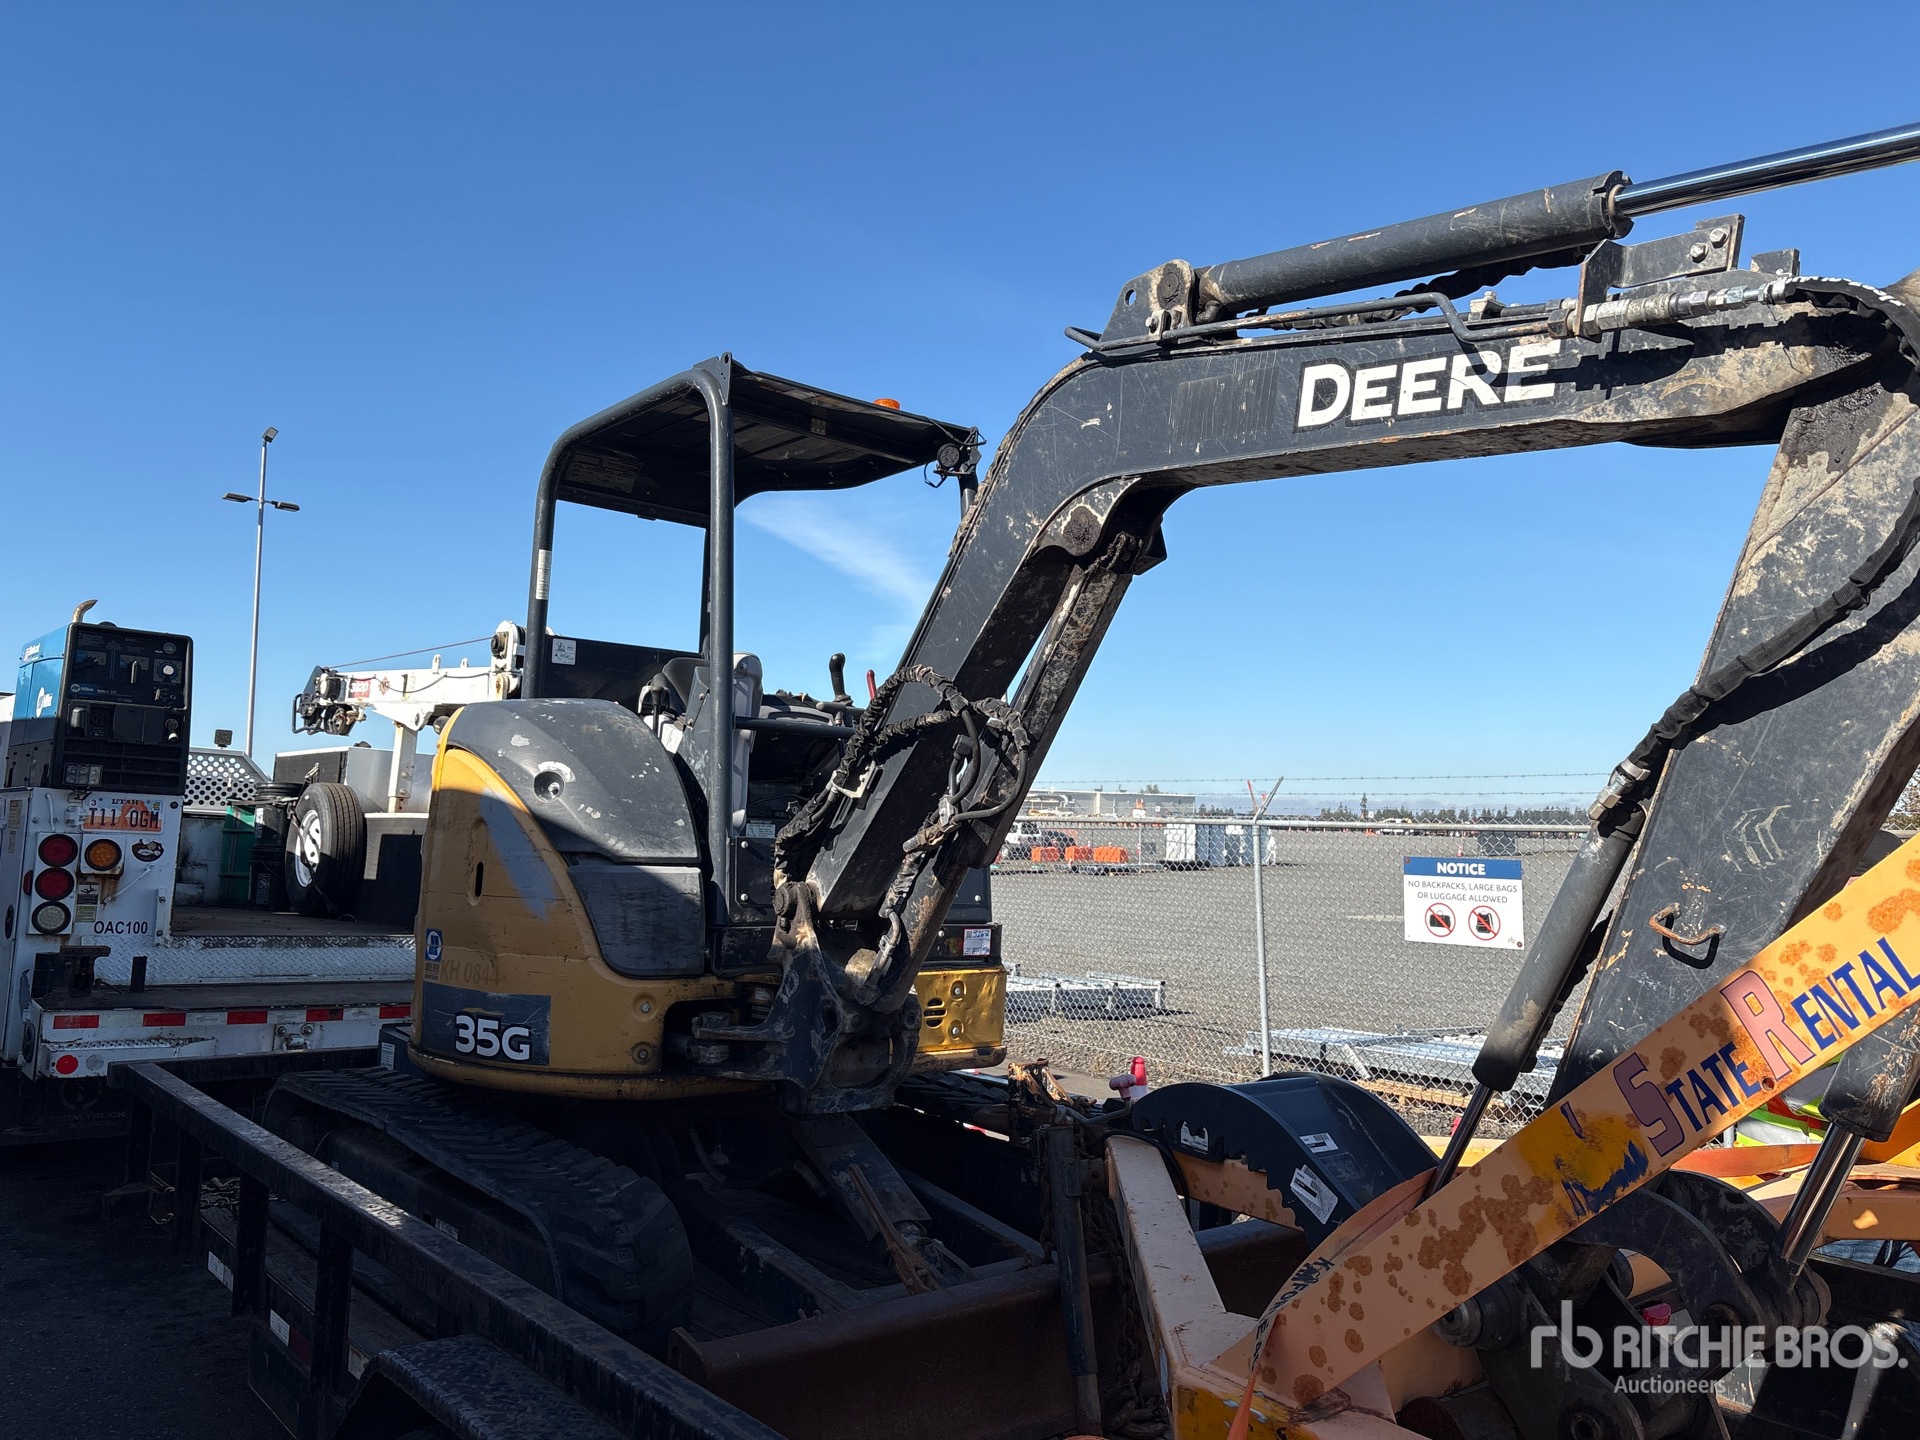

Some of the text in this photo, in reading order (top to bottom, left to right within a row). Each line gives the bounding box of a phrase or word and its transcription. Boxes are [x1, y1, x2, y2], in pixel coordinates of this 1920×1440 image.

[1297, 338, 1561, 428] DEERE
[89, 808, 117, 827] T11
[1436, 862, 1486, 876] NOTICE
[1422, 881, 1467, 891] BACKPACKS,
[1469, 883, 1494, 892] LARGE
[1496, 885, 1518, 893] BAGS
[1430, 892, 1467, 901] LUGGAGE
[1468, 895, 1508, 904] ALLOWED
[93, 920, 148, 935] OAC100
[455, 1014, 530, 1061] 35G
[1612, 1041, 1762, 1158] STATE
